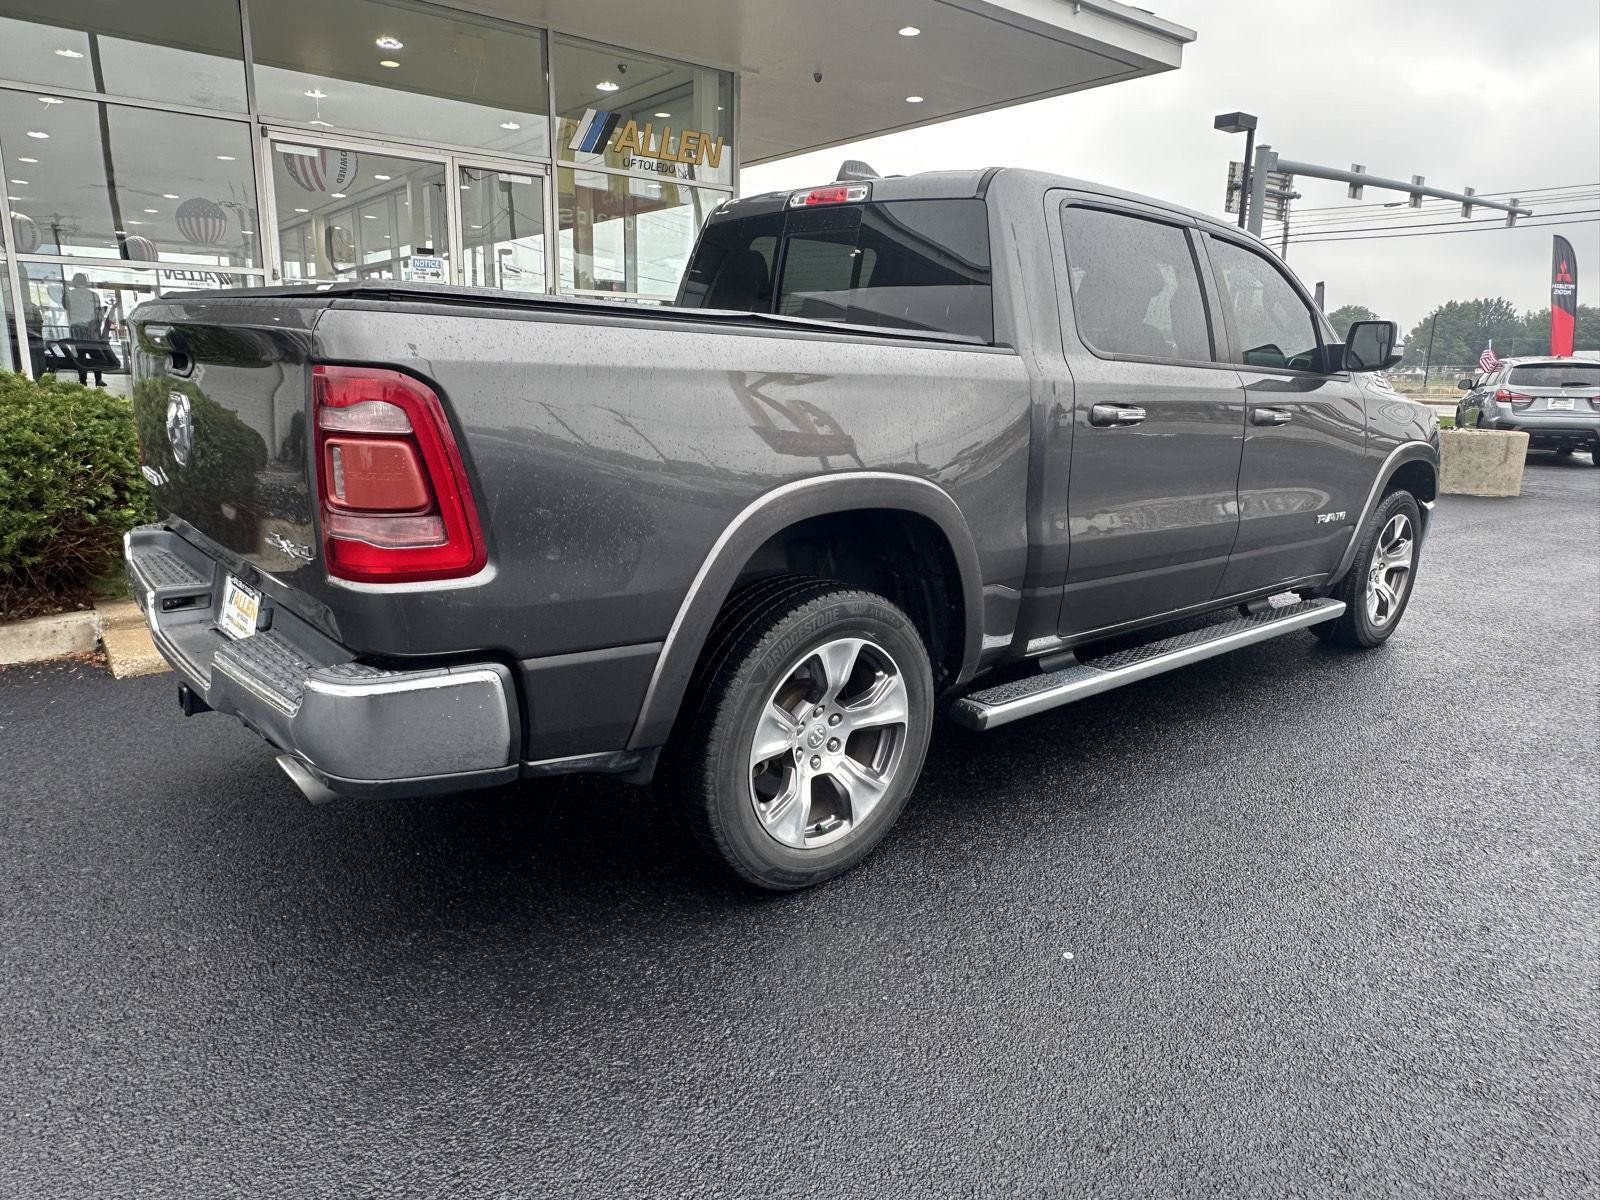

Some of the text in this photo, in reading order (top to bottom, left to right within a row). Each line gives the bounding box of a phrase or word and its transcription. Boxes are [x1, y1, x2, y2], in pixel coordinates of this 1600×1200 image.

[614, 119, 724, 169] ALLEN
[623, 157, 676, 174] OF TOLEDO
[414, 259, 440, 268] NOTICE
[1317, 511, 1346, 523] RAM
[761, 608, 840, 675] BRIDGESTONE
